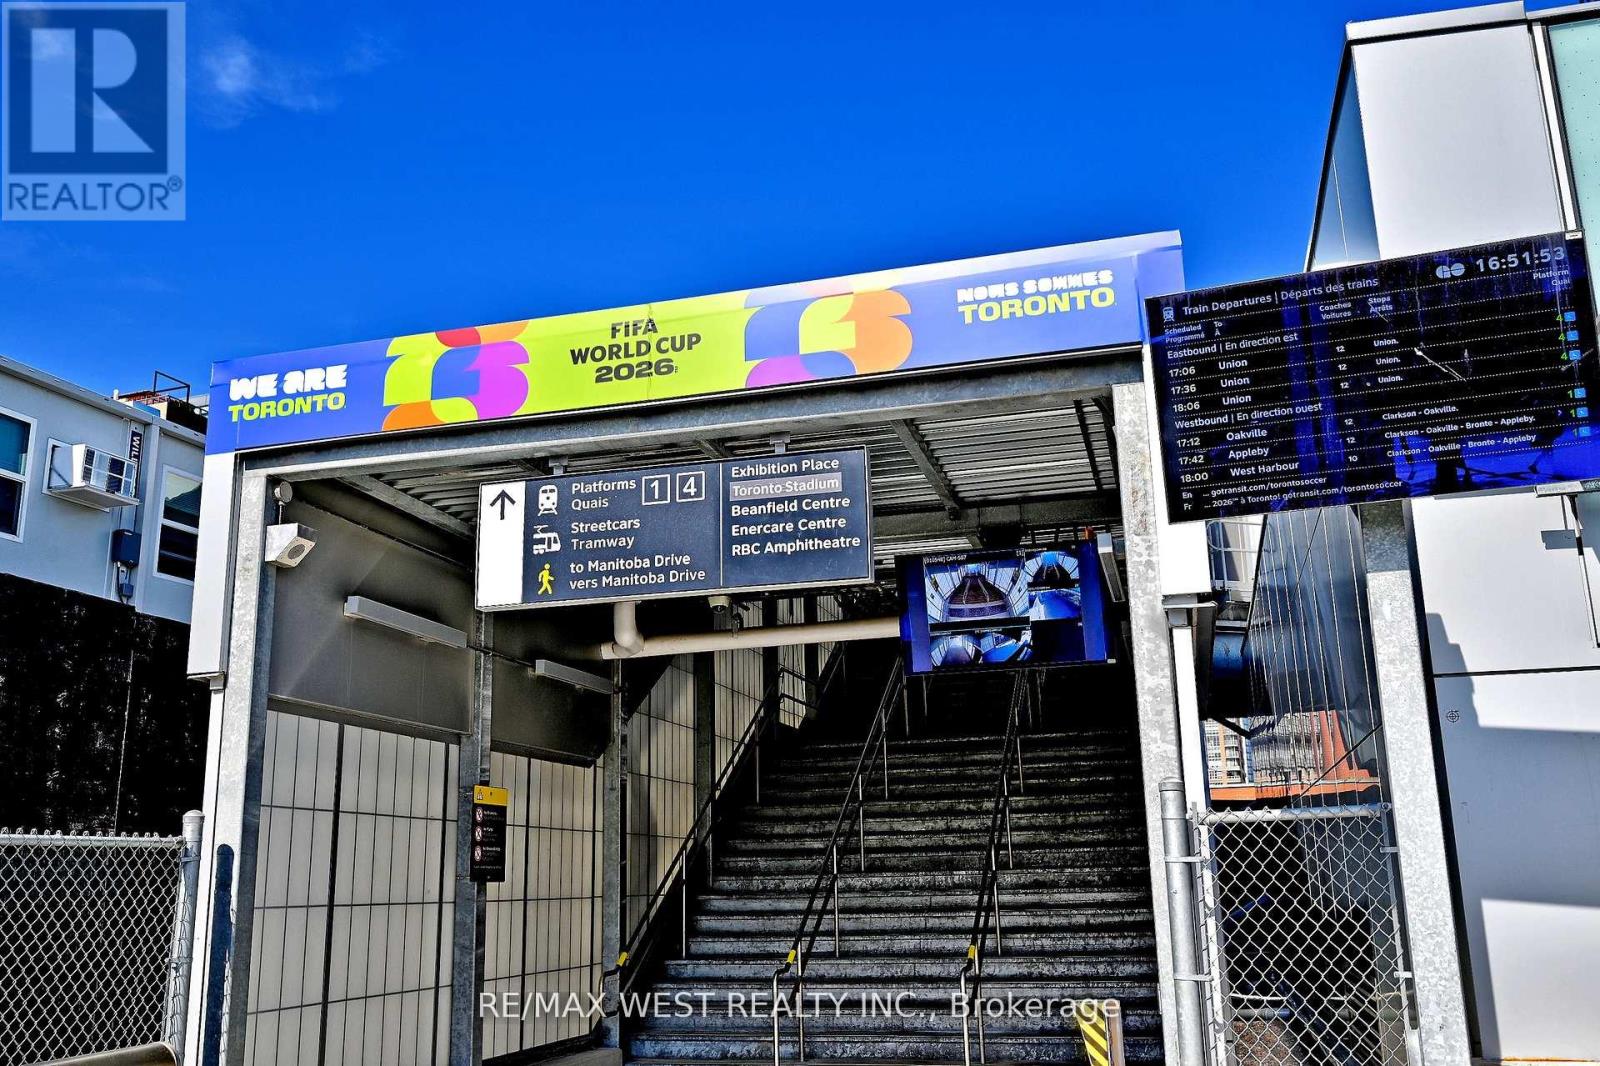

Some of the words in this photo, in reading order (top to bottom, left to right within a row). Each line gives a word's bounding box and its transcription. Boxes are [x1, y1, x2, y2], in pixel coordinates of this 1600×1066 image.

[1476, 247, 1565, 272] 16:51:53
[1533, 269, 1569, 280] Platform
[957, 282, 1019, 303] NOUS
[1023, 269, 1113, 294] SOMMES
[1182, 304, 1209, 316] Train
[1212, 294, 1272, 311] Departures
[1281, 286, 1323, 301] Départs
[1325, 283, 1345, 294] des
[1347, 278, 1379, 290] trains
[958, 287, 1115, 325] TORONTO
[1320, 301, 1352, 312] Coaches
[1368, 295, 1391, 304] Stops
[1321, 311, 1352, 320] Voitures
[611, 318, 658, 339] FIFA
[1164, 324, 1202, 335] Scheduled
[1165, 332, 1205, 344] Programmé
[570, 341, 651, 365] WORLD
[656, 333, 702, 354] CUP
[1167, 343, 1217, 359] Eastbound
[1225, 342, 1237, 351] En
[1239, 335, 1281, 349] direction
[1283, 332, 1298, 341] est
[1169, 366, 1196, 378] 17:06
[1219, 359, 1248, 370] Union
[1336, 345, 1346, 353] 12
[1373, 337, 1399, 347] Union.
[1171, 384, 1197, 395] 17:36
[1220, 377, 1250, 388] Union
[1338, 363, 1347, 371] 12
[1376, 356, 1401, 365] Union.
[1558, 333, 1565, 341] 4
[229, 373, 278, 401] WE
[282, 364, 347, 394] ARE
[1173, 401, 1200, 413] 18:06
[1223, 395, 1252, 405] Union
[1378, 374, 1403, 383] Union.
[229, 392, 345, 422] TORONTO
[1175, 415, 1228, 429] Westbound
[1237, 411, 1249, 420] En
[1251, 406, 1293, 419] direction
[1295, 402, 1323, 414] ouest
[1177, 437, 1200, 448] 17:12
[1226, 428, 1267, 441] Oakville
[1382, 410, 1416, 420] Clarkson
[1424, 405, 1459, 415] Oakville.
[1567, 390, 1573, 399] 1
[1178, 454, 1204, 465] 17:42
[1228, 447, 1269, 460] Appleby
[1384, 428, 1419, 439] Clarkson
[1425, 424, 1459, 434] Oakville
[1465, 419, 1493, 429] Bronte
[1500, 414, 1536, 425] Appleby.
[1570, 408, 1575, 417] 1
[731, 462, 798, 477] Exhibition
[802, 459, 840, 471] Place
[1180, 472, 1208, 483] 18:00
[1230, 467, 1256, 477] West
[1258, 462, 1299, 473] Harbour
[1387, 447, 1420, 457] Clarkson
[1428, 443, 1461, 453] Oakville
[1468, 438, 1495, 448] Bronte
[1502, 433, 1537, 445] Appleby
[571, 479, 637, 494] Platforms
[650, 480, 659, 499] 1
[682, 476, 697, 496] 4
[733, 483, 782, 497] Toronto
[785, 478, 839, 493] Stadium
[1182, 491, 1193, 499] En
[1211, 477, 1327, 498] gotransit.com/torontosoccer
[1183, 503, 1192, 511] Fr
[1247, 494, 1280, 503] Toronto!
[1282, 481, 1403, 501] gotransit.com/torontosoccer
[571, 496, 609, 511] Quais
[731, 499, 797, 517] Beanfield
[802, 497, 851, 511] Centre
[571, 519, 640, 534] Streetcars
[731, 522, 794, 536] Enercare
[798, 517, 847, 531] Centre
[571, 535, 635, 550] Tramway
[732, 543, 761, 556] RBC
[764, 536, 861, 555] Amphitheatre
[570, 562, 584, 573] to
[588, 556, 650, 572] Manitoba
[655, 553, 691, 567] Drive
[569, 578, 598, 589] vers
[602, 572, 665, 587] Manitoba
[669, 569, 706, 583] Drive
